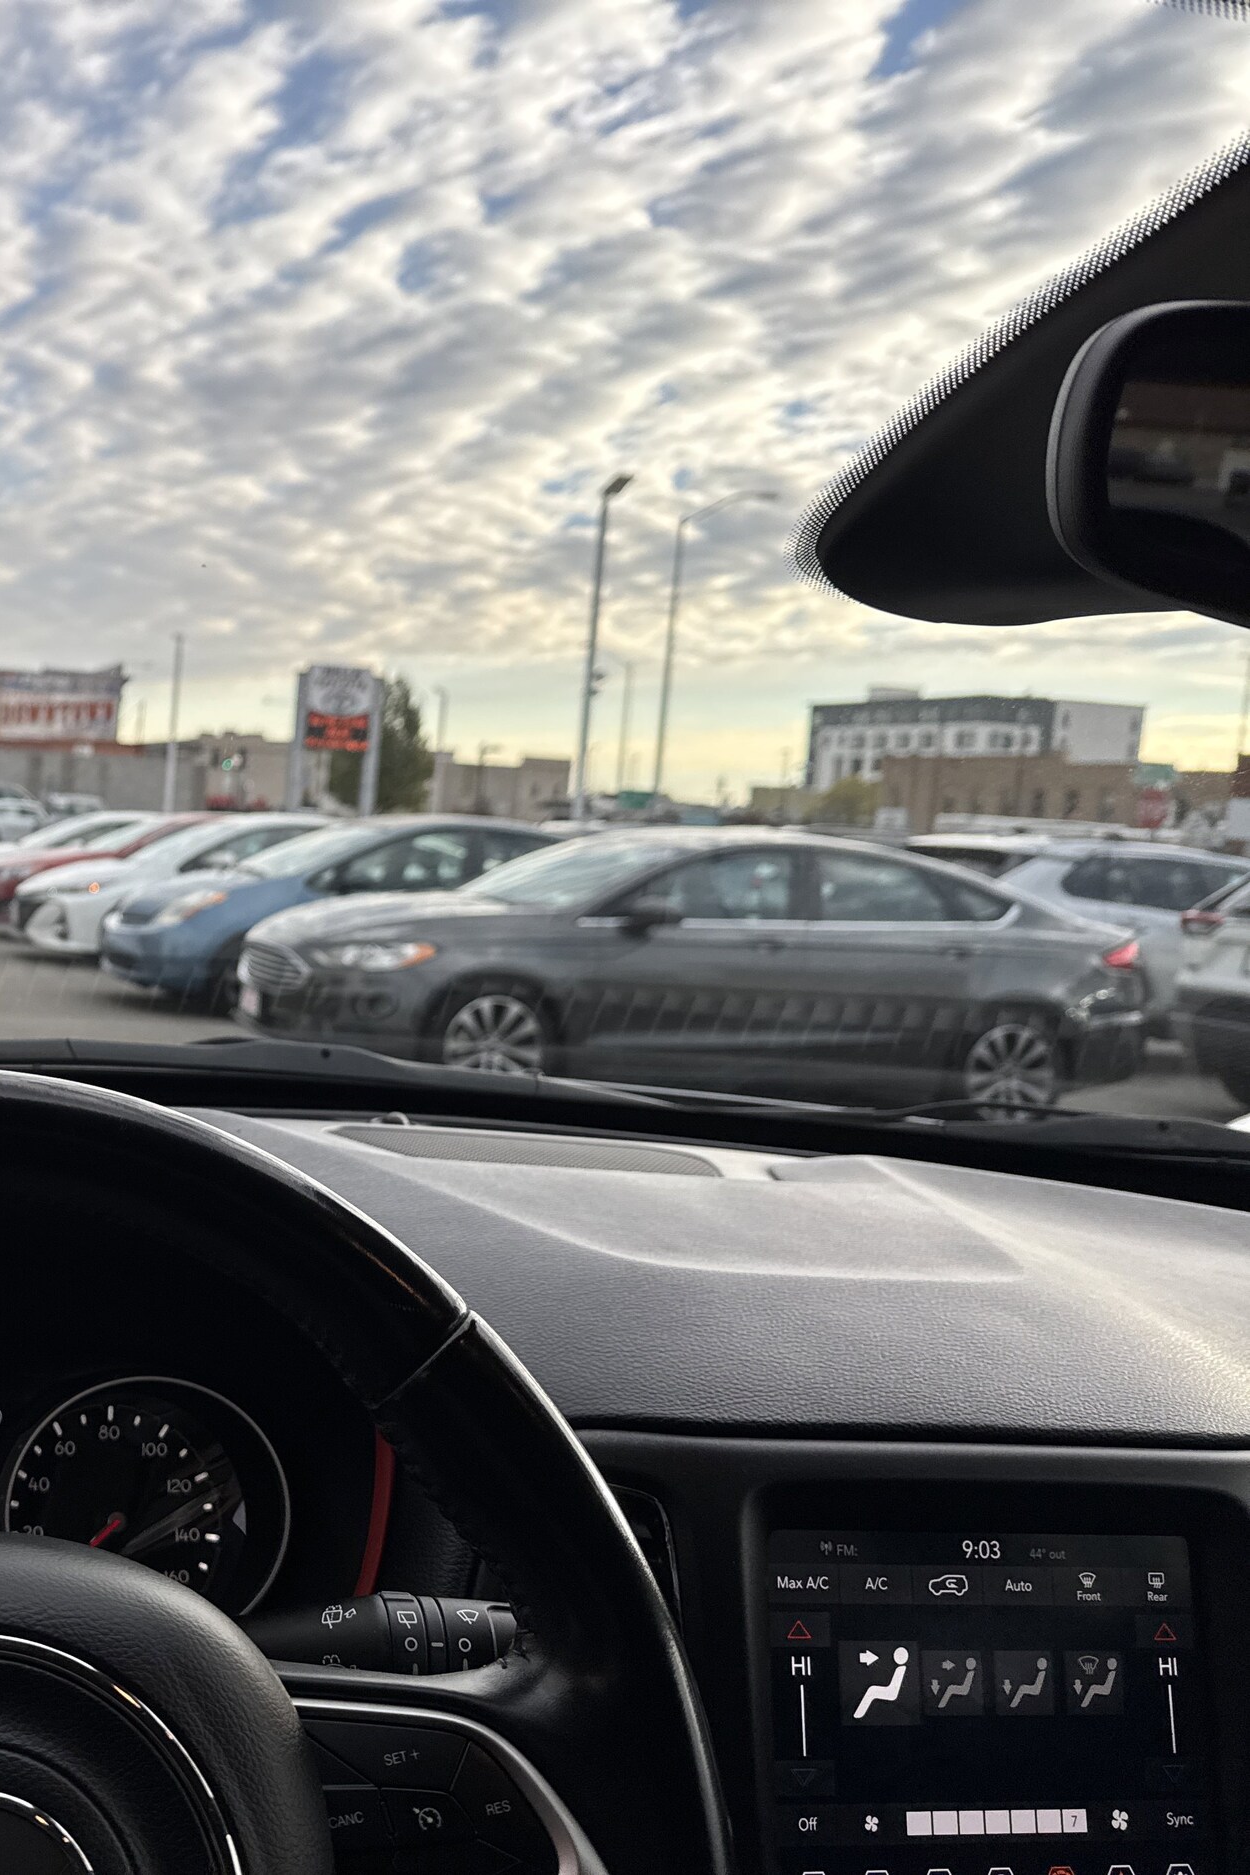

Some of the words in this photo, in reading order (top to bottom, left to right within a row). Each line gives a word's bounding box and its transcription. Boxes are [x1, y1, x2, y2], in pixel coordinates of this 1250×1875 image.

[98, 1424, 121, 1441] 80
[54, 1440, 76, 1456] 60
[141, 1442, 168, 1457] 100
[27, 1476, 50, 1492] 40
[166, 1478, 192, 1494] 120
[174, 1526, 200, 1543] 140
[962, 1539, 1001, 1559] 9:03
[1048, 1550, 1067, 1560] out
[777, 1576, 802, 1590] Max
[805, 1576, 829, 1590] A/C
[865, 1576, 888, 1591] A/C
[1005, 1579, 1033, 1592] Auto
[1076, 1590, 1102, 1602] Front
[1147, 1590, 1169, 1602] Rear
[791, 1655, 812, 1676] HI
[1158, 1657, 1178, 1676] HI
[383, 1750, 407, 1766] SET
[485, 1799, 511, 1816] RES
[328, 1811, 364, 1829] CANC
[798, 1816, 818, 1832] Off
[1070, 1815, 1078, 1828] 7
[1166, 1811, 1194, 1828] Sync
